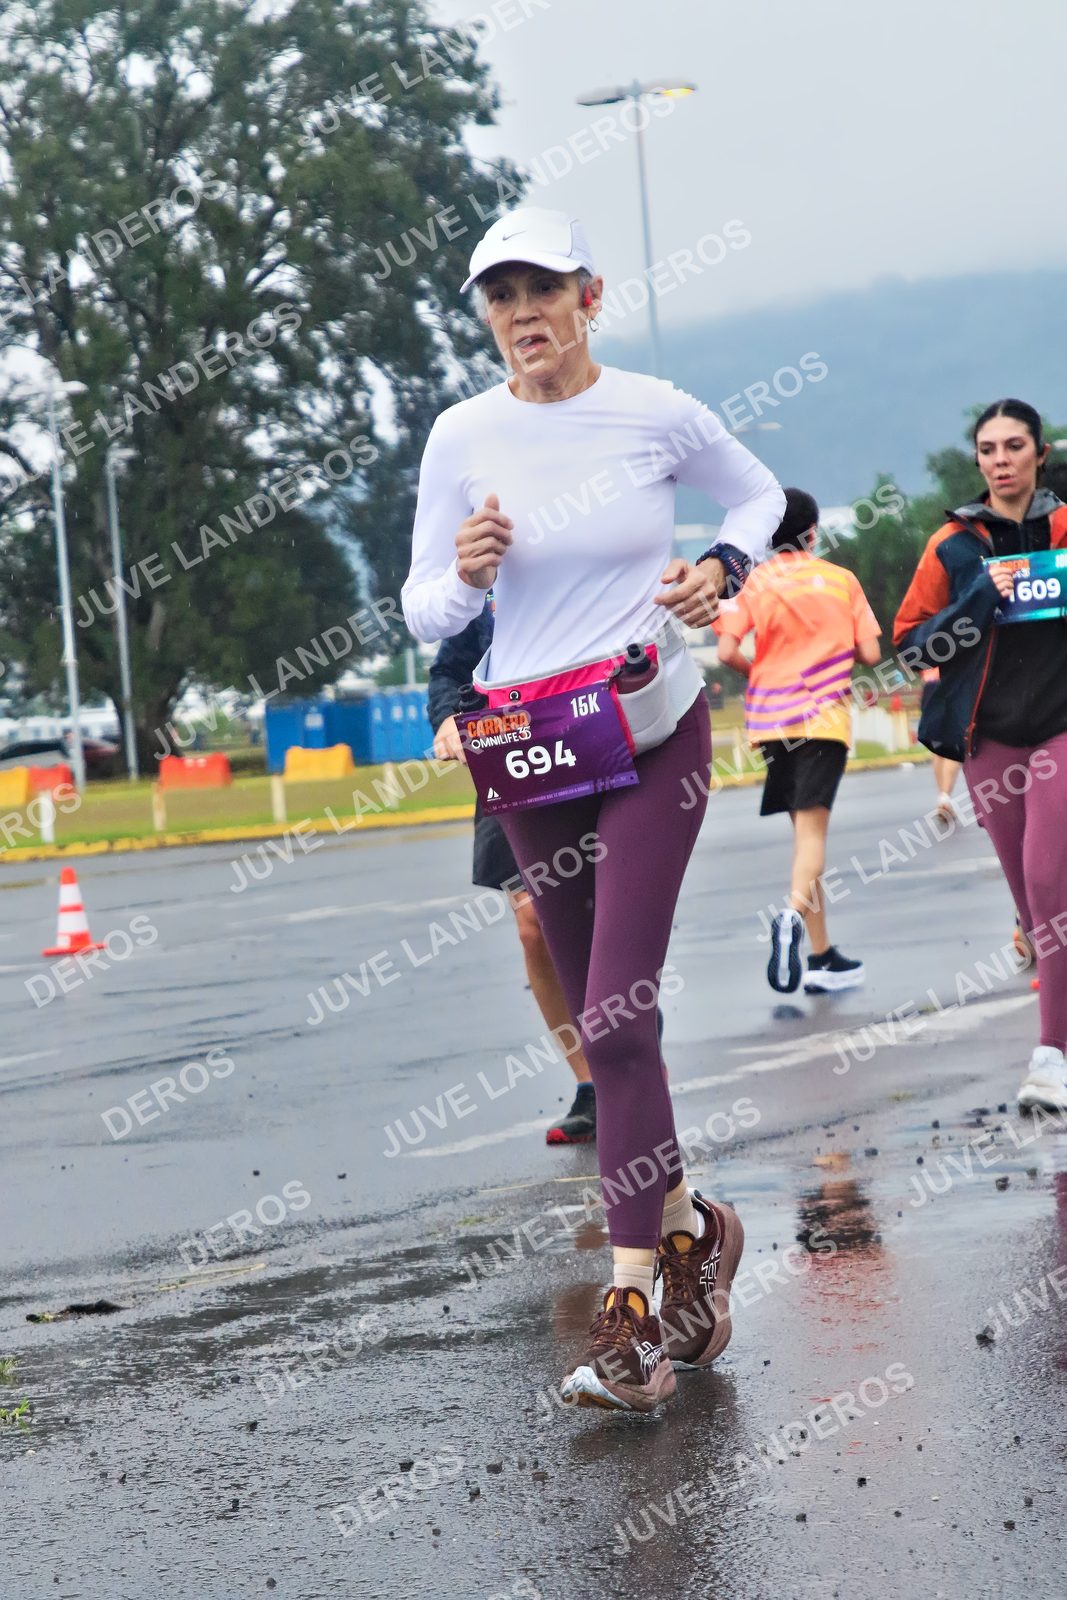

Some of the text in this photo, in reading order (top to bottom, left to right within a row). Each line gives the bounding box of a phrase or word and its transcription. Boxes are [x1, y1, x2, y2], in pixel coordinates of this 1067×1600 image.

[570, 692, 600, 718] 15K
[467, 712, 530, 737] CARRERA
[472, 732, 519, 749] OMNILIFE
[505, 740, 577, 779] 694
